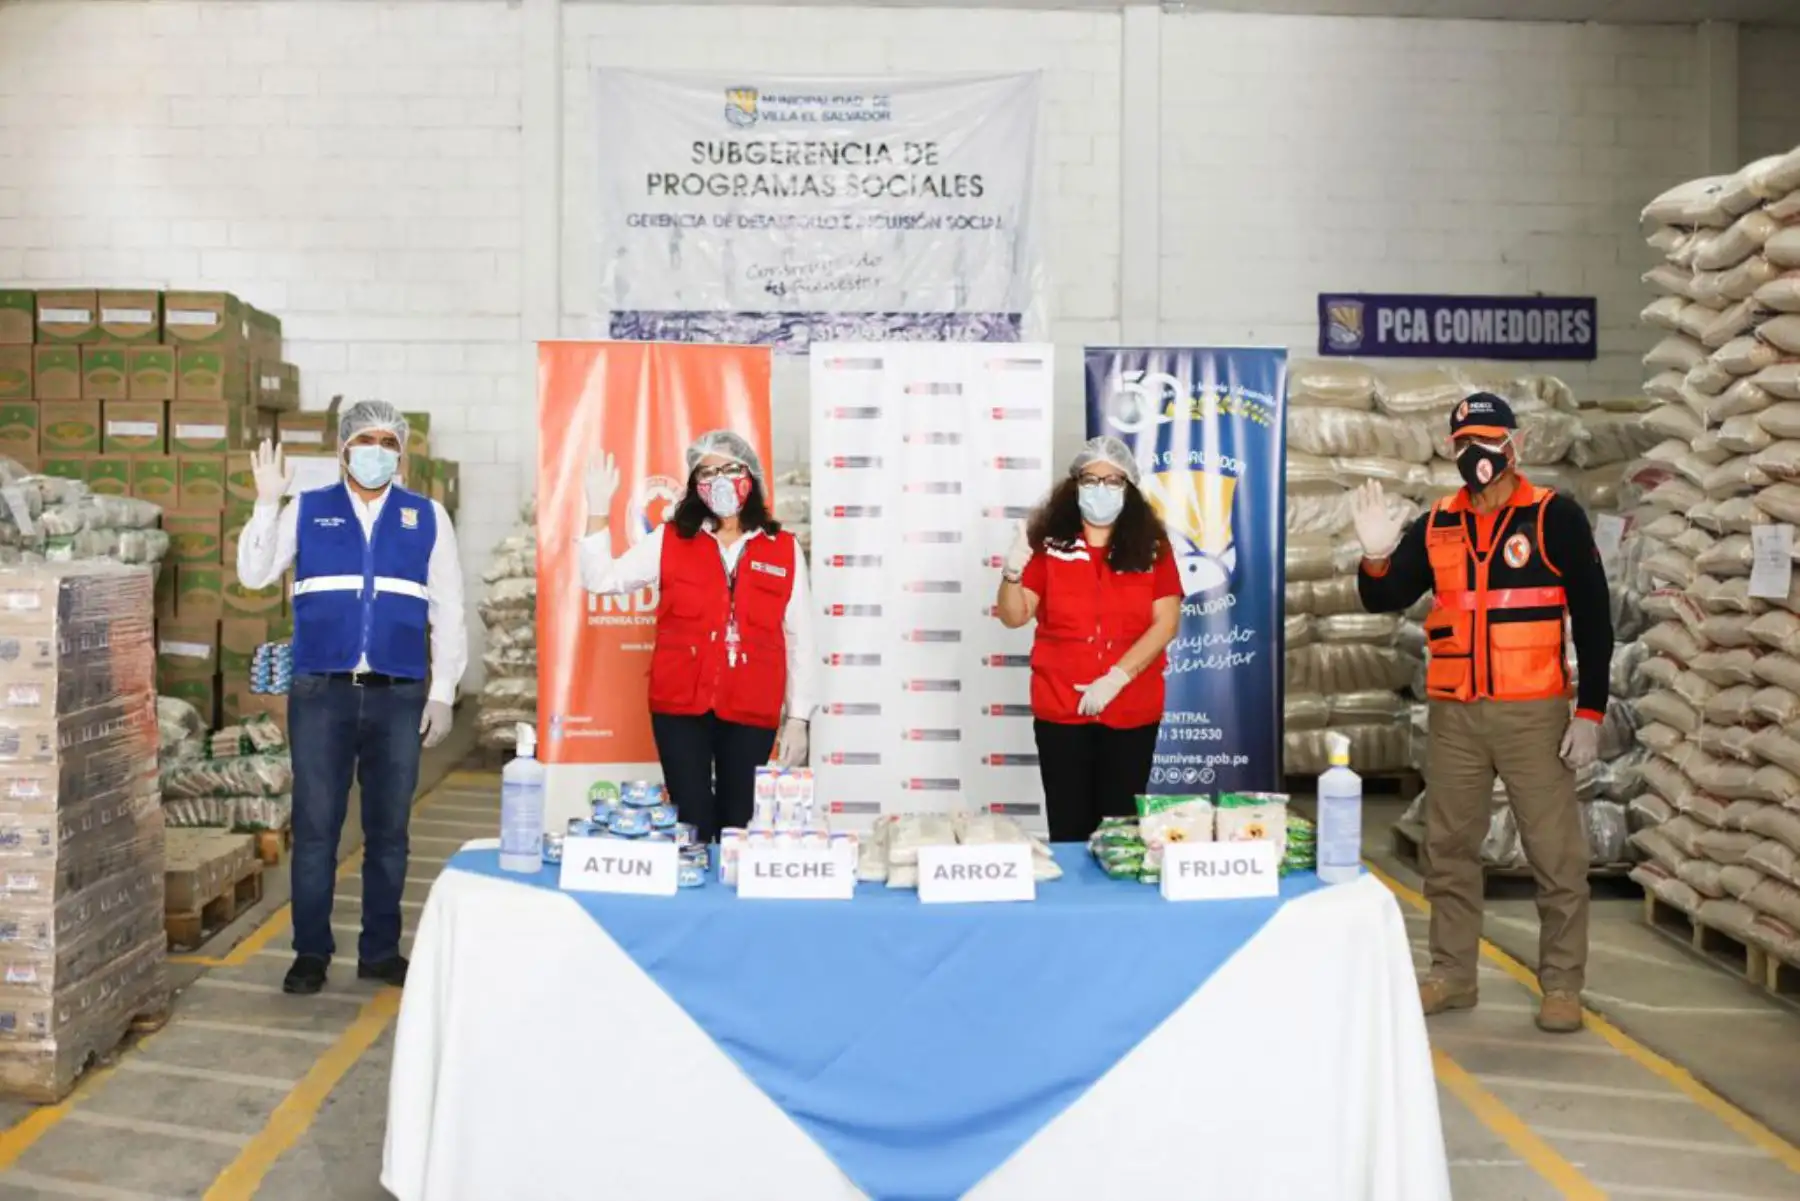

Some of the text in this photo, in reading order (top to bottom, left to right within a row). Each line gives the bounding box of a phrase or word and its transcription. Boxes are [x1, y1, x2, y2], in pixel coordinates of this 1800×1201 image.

[872, 95, 890, 107] DE
[762, 111, 891, 122] VILLA EL SALVADOR
[691, 141, 939, 166] SUBGERENCIA DE
[646, 172, 984, 198] PROGRAMAS SOCIALES
[626, 212, 706, 228] GERENCIA
[712, 213, 734, 228] DE
[857, 210, 942, 231] CLUSIÓN
[945, 213, 1003, 230] SOCIAL
[1377, 308, 1592, 344] PCA COMEDORES
[1170, 728, 1223, 740] 3192530
[584, 856, 653, 876] ATUN
[754, 861, 836, 878] LECHE
[933, 861, 1018, 881] ARROZ
[1179, 857, 1264, 878] FRIJOL
